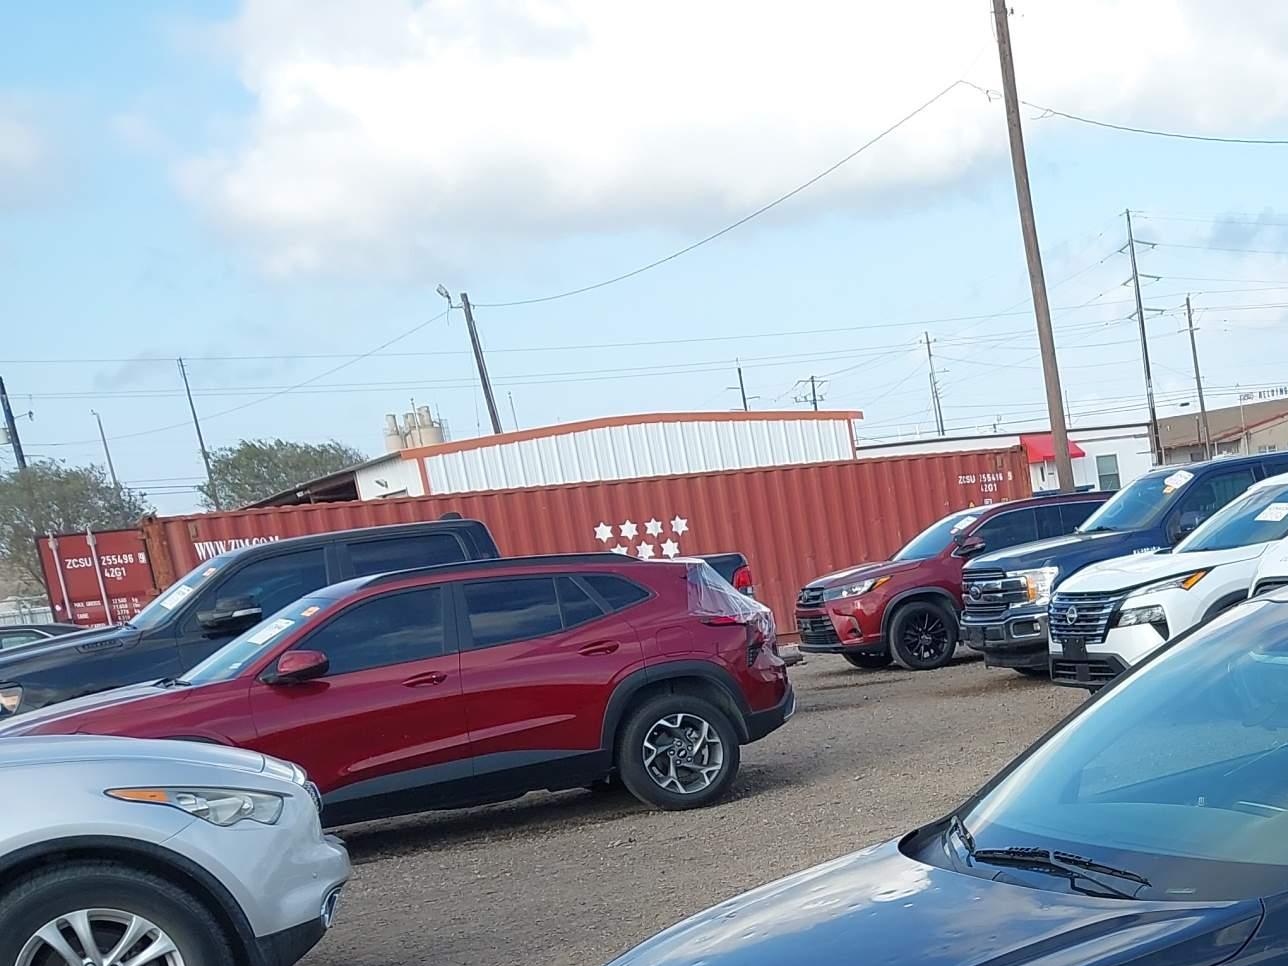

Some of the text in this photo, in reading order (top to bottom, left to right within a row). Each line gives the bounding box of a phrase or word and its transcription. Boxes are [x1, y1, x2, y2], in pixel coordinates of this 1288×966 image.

[65, 557, 92, 569] ZCSU
[100, 554, 134, 566] 255496
[104, 567, 127, 578] 42G1
